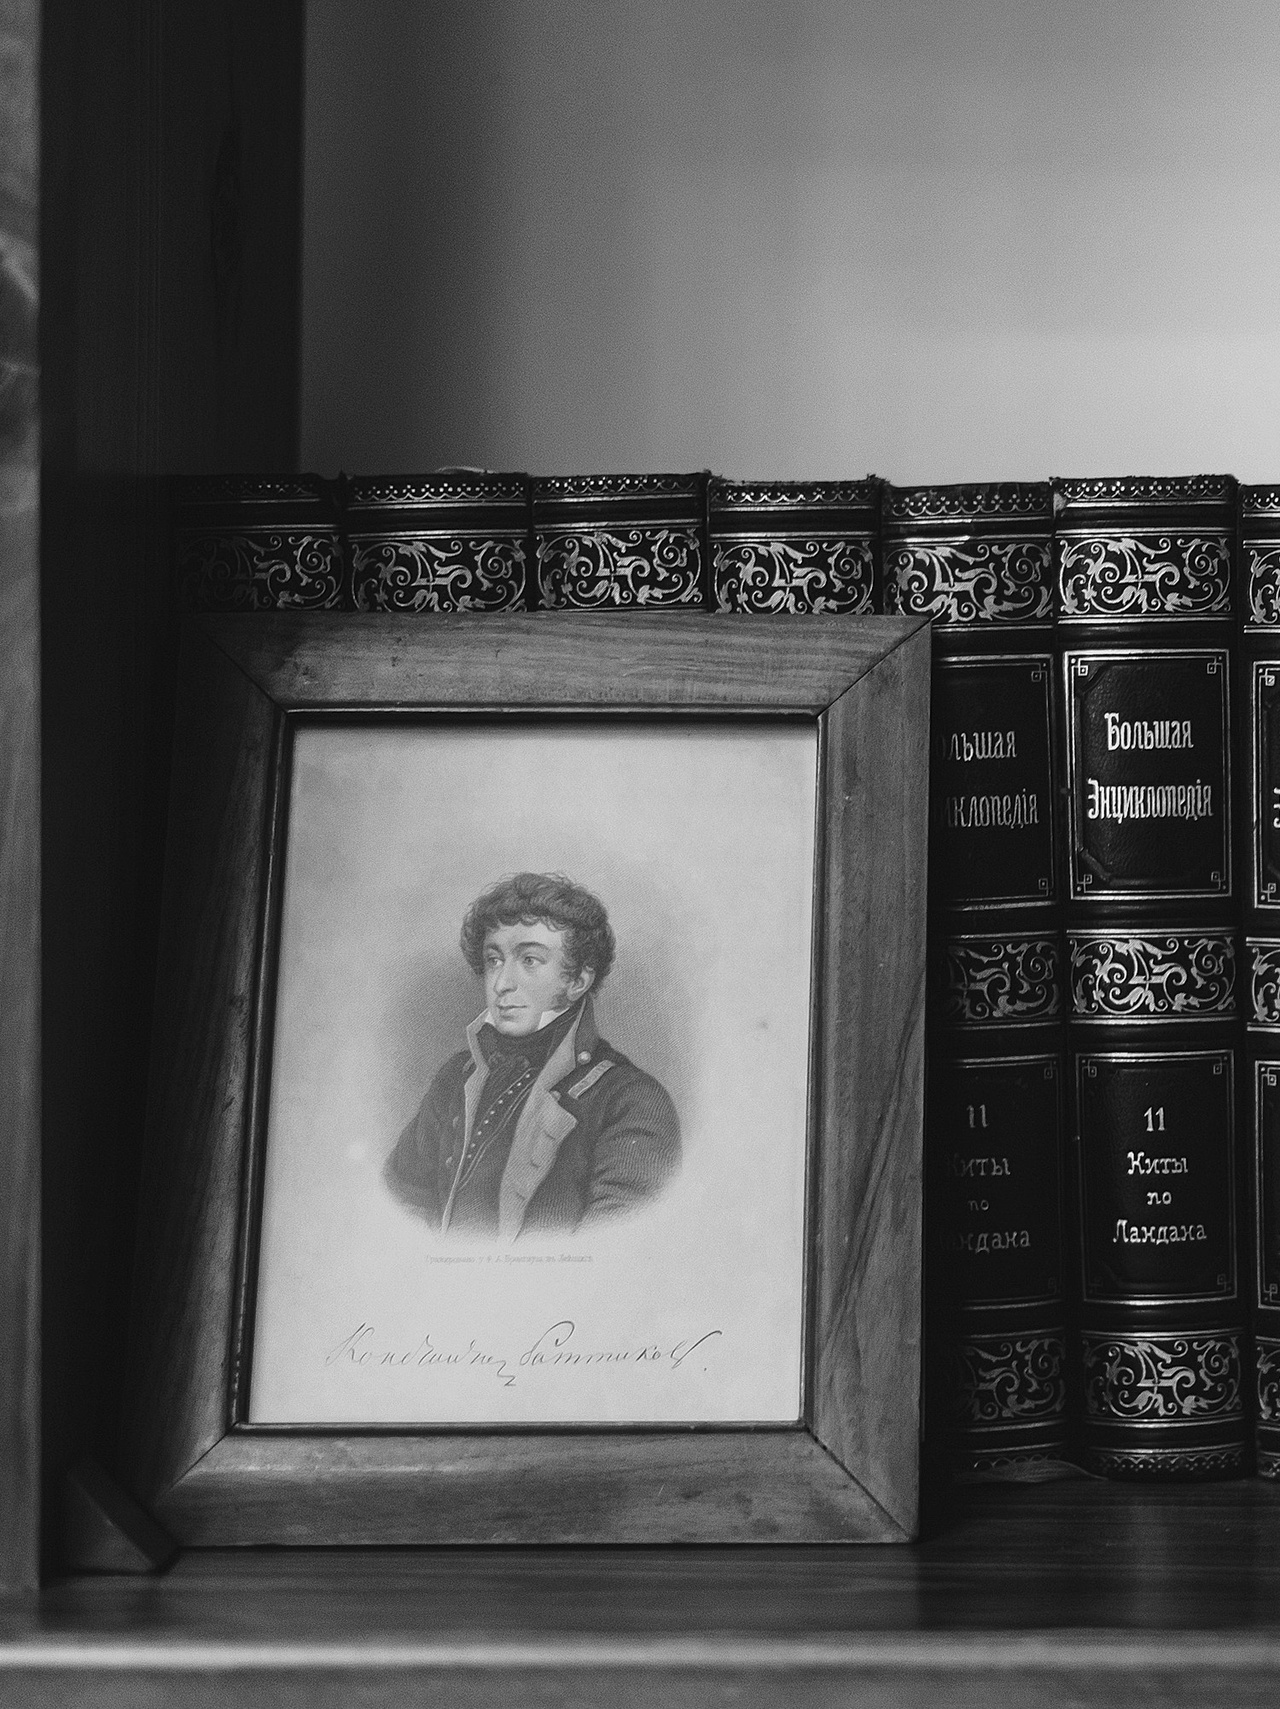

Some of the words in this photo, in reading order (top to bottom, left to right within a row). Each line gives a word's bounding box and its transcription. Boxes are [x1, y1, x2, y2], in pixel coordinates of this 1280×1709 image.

[1104, 713, 1193, 750] Большая
[943, 731, 1017, 762] льшая
[946, 788, 1039, 829] клопедія
[1088, 778, 1212, 824] Энциклопедія
[967, 1104, 988, 1128] 11
[1144, 1107, 1164, 1132] 11
[1127, 1152, 1188, 1174] Киты
[1147, 1192, 1171, 1205] по
[1113, 1219, 1206, 1245] Ландана
